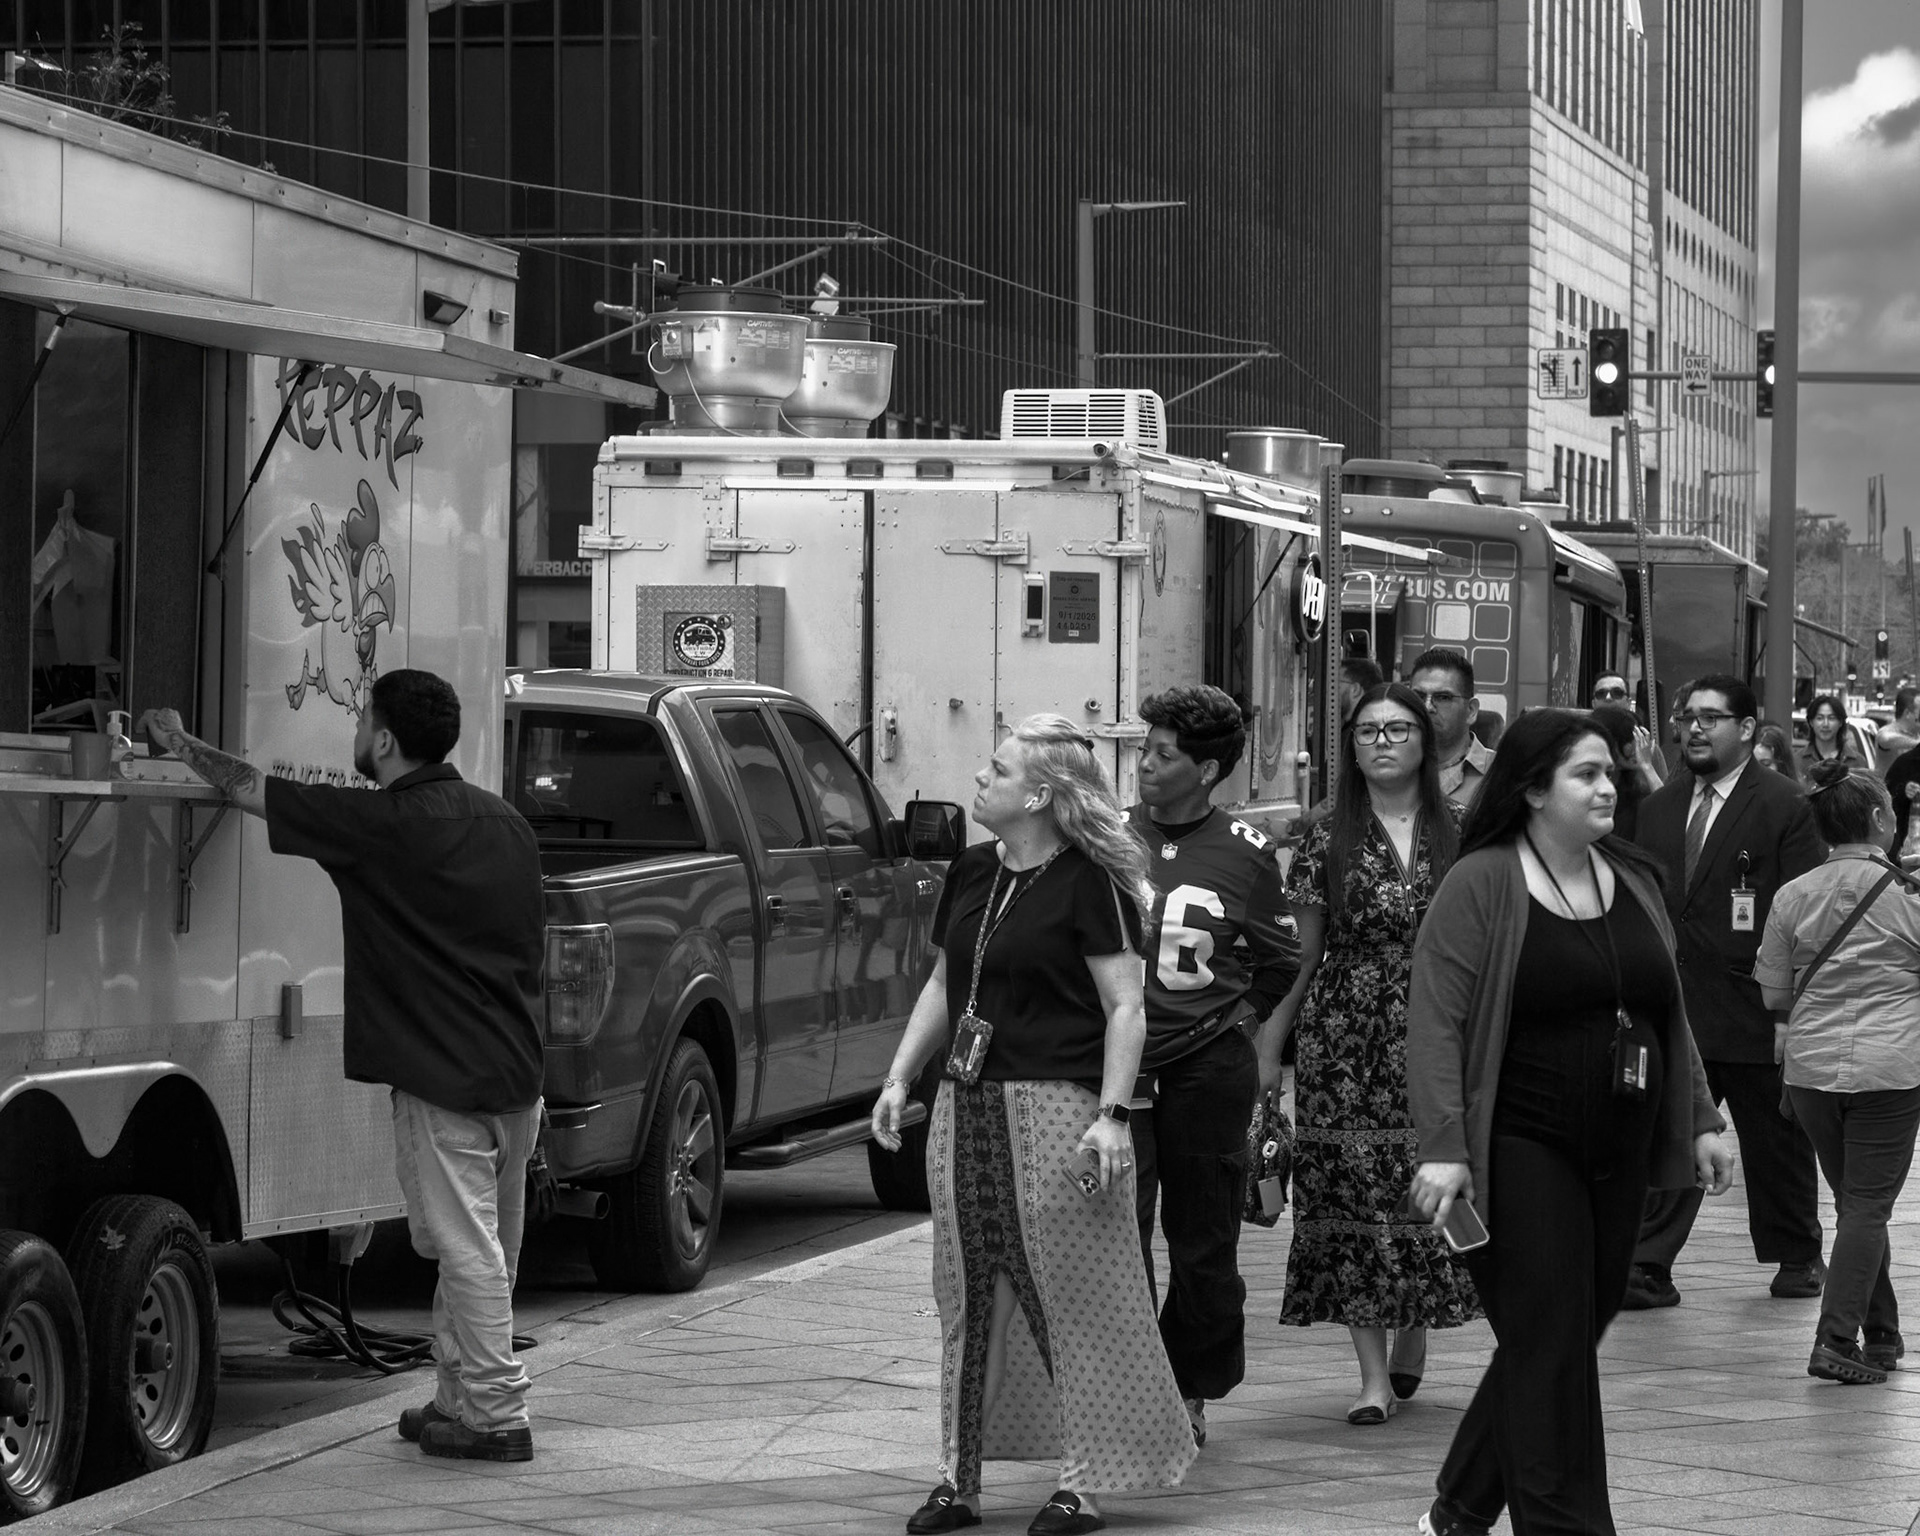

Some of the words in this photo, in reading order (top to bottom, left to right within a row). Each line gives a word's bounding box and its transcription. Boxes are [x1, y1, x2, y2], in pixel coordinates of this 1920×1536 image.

[1685, 359, 1708, 369] ONE
[1684, 370, 1709, 380] WAY
[1567, 388, 1585, 397] ONLY
